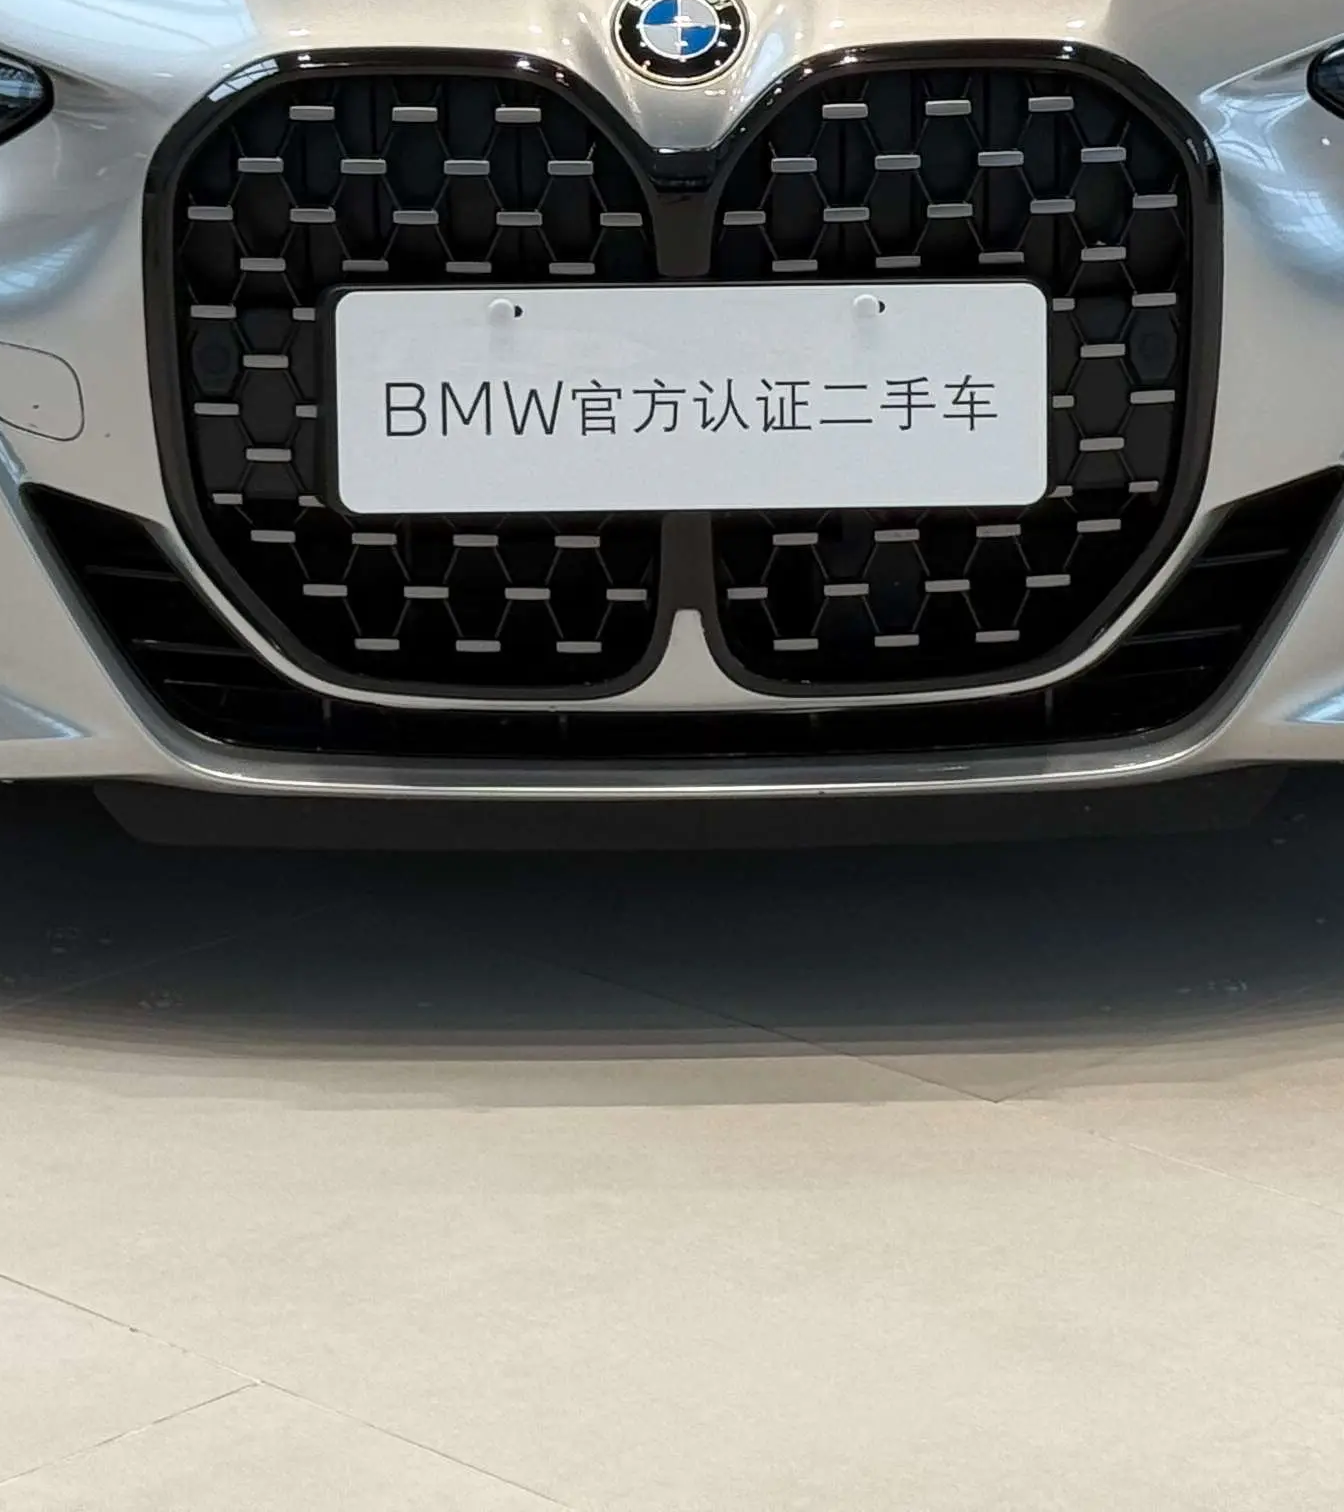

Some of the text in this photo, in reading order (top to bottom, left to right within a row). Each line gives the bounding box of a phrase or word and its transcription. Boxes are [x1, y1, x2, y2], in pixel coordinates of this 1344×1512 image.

[385, 374, 998, 437] BMW官方认证二手车
